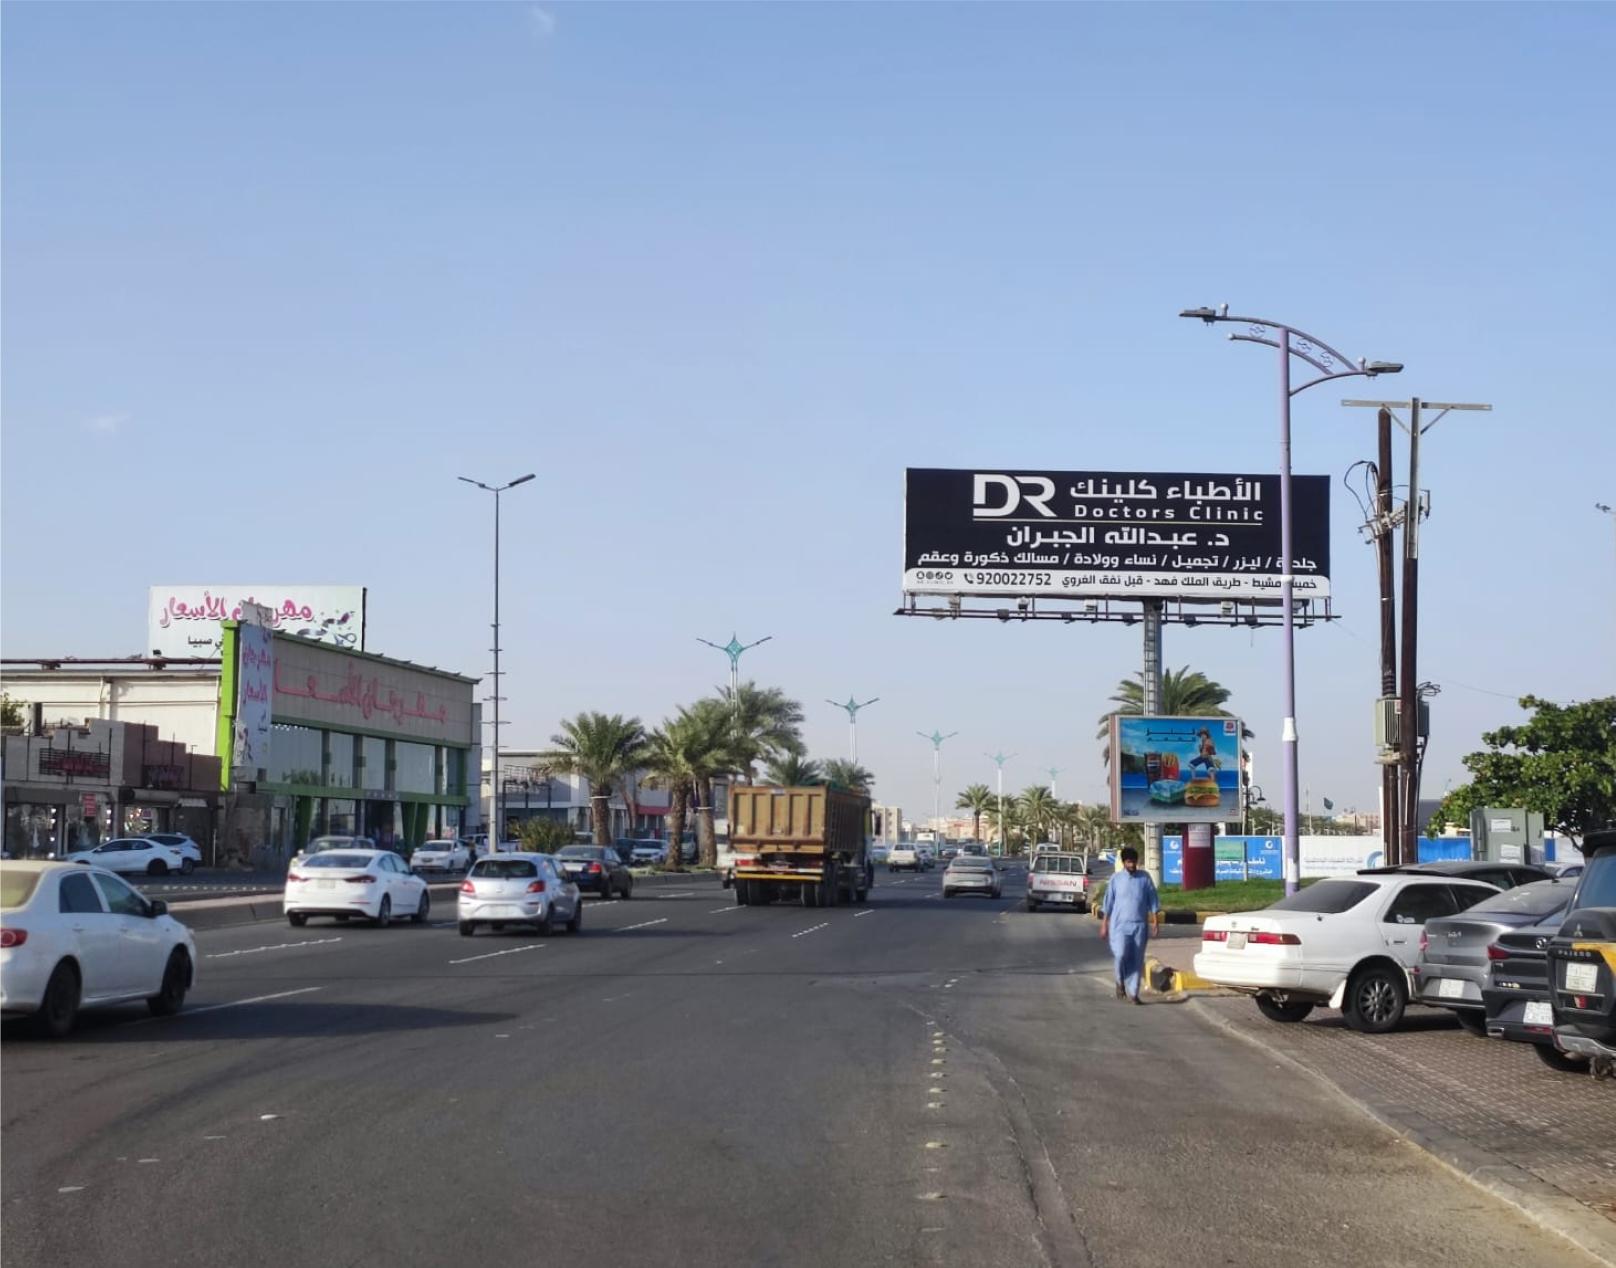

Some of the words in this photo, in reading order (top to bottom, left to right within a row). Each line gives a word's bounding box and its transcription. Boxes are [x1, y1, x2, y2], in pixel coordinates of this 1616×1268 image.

[973, 474, 1058, 517] DR
[1070, 479, 1158, 504] كلينك
[1166, 477, 1261, 505] الأطباء
[1075, 505, 1176, 519] Doctors
[1189, 506, 1264, 521] Clinic
[1006, 526, 1095, 549] الجبران
[1105, 526, 1197, 549] عبدالله
[1207, 532, 1230, 546] د.
[917, 550, 960, 566] وعقم
[964, 551, 1010, 567] ذكورة
[1013, 552, 1059, 565] مسالك
[1074, 552, 1120, 568] وولادة
[1124, 554, 1157, 566] نساء
[1172, 554, 1219, 570] تجميل
[1232, 555, 1261, 571] ليزر
[1276, 556, 1317, 572] جلدة
[976, 572, 1052, 586] 920022752
[1099, 575, 1121, 585] نفق
[1124, 575, 1143, 587] قبل
[1154, 576, 1178, 587] فهد
[1181, 576, 1209, 587] الملك
[1213, 576, 1241, 590] طريق
[1252, 577, 1282, 591] مشيط
[159, 590, 229, 629] الأسعار
[231, 596, 314, 629] مهرن
[187, 635, 213, 648] صبيا
